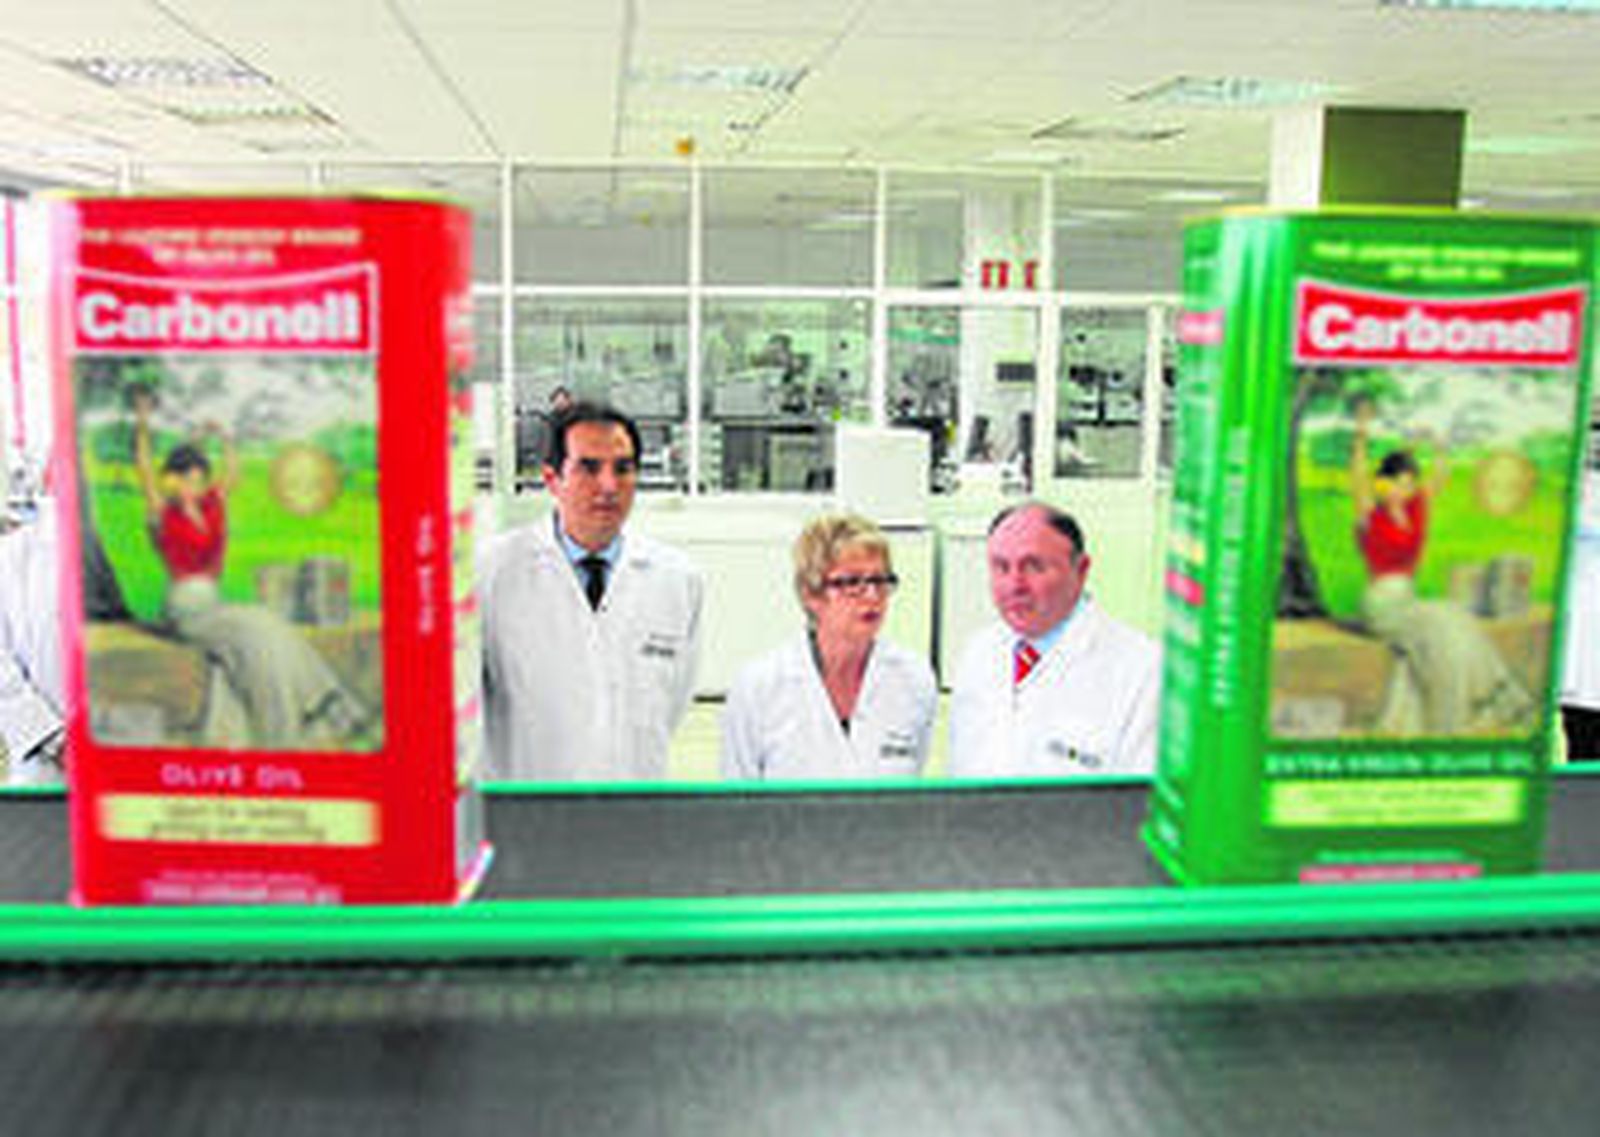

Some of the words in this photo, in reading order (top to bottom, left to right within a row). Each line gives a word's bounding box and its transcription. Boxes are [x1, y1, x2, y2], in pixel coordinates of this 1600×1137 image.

[79, 292, 361, 341] Carbonell
[1307, 303, 1573, 354] Carbonell
[160, 763, 243, 788] OLIVE
[255, 764, 305, 789] OIL
